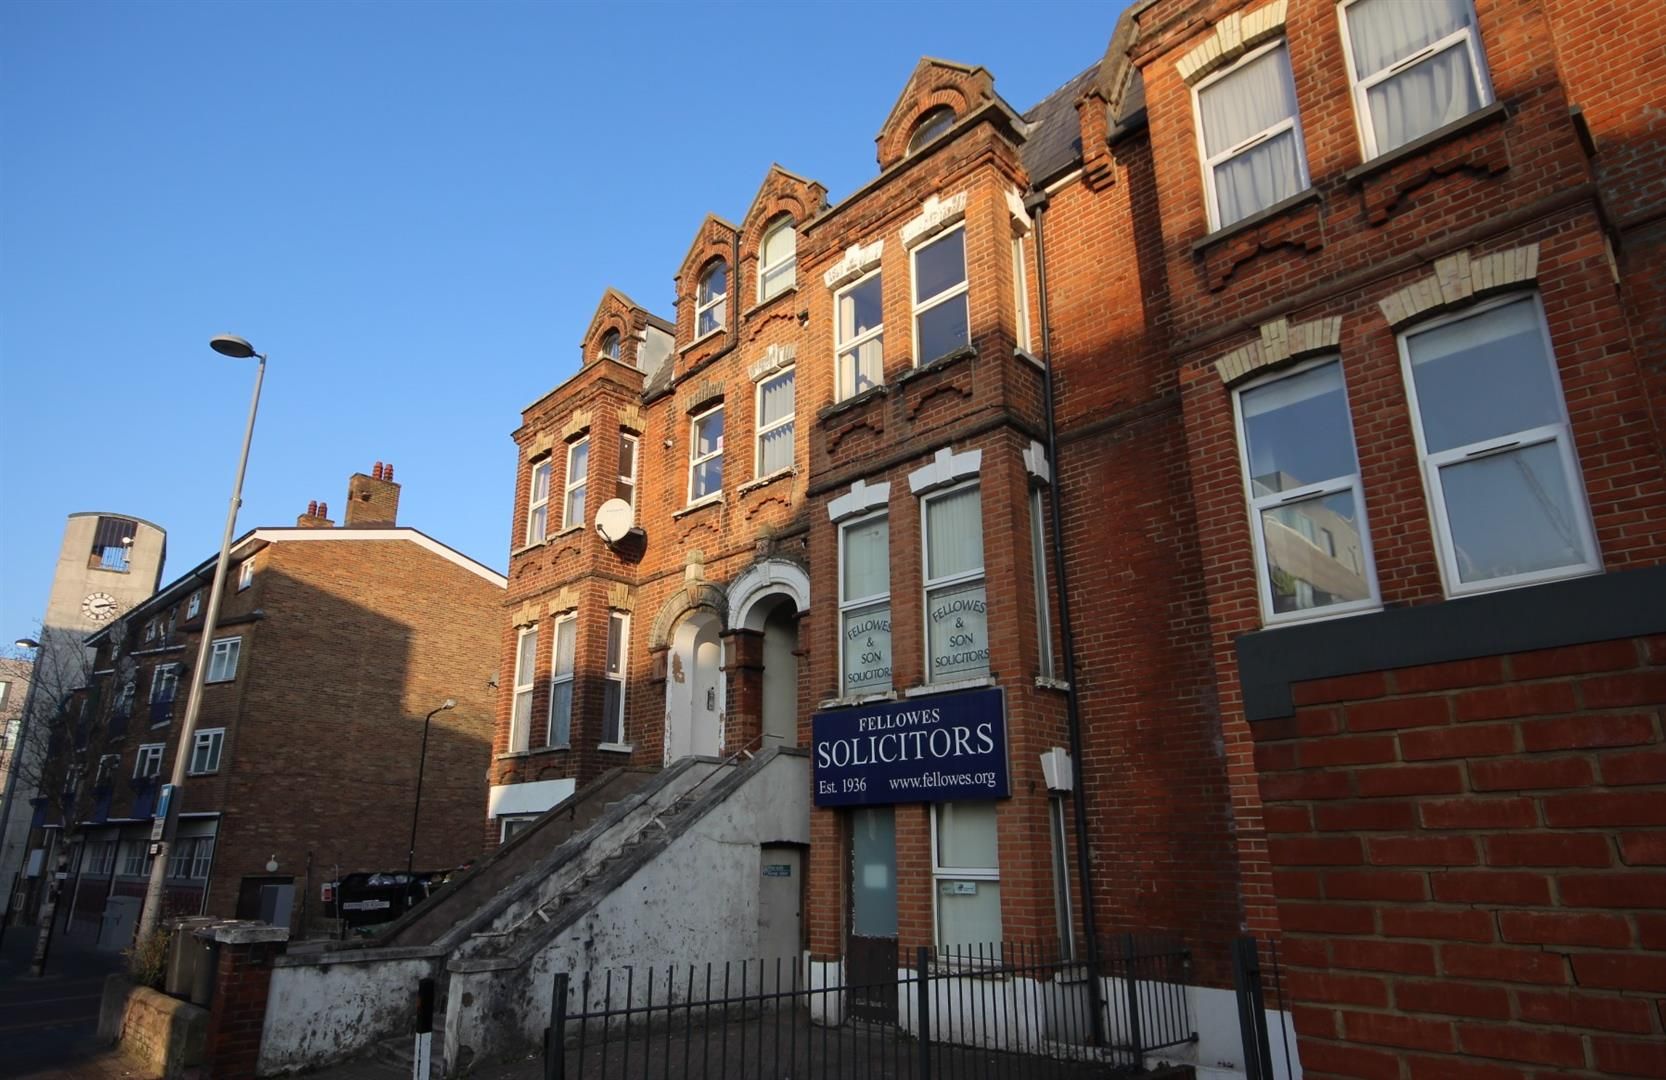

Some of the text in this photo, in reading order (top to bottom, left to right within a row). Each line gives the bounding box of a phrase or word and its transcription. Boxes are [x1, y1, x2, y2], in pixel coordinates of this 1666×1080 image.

[932, 600, 986, 623] FELLOWES
[955, 617, 964, 628] &
[866, 637, 874, 647] &
[949, 633, 974, 648] SON
[861, 650, 881, 664] SON
[935, 648, 990, 668] SOLICITORS
[859, 708, 940, 732] FELLOWES
[818, 722, 994, 769] SOLICITORS
[819, 777, 867, 794] Est. 1936
[889, 771, 996, 788] www.fellowes.org
